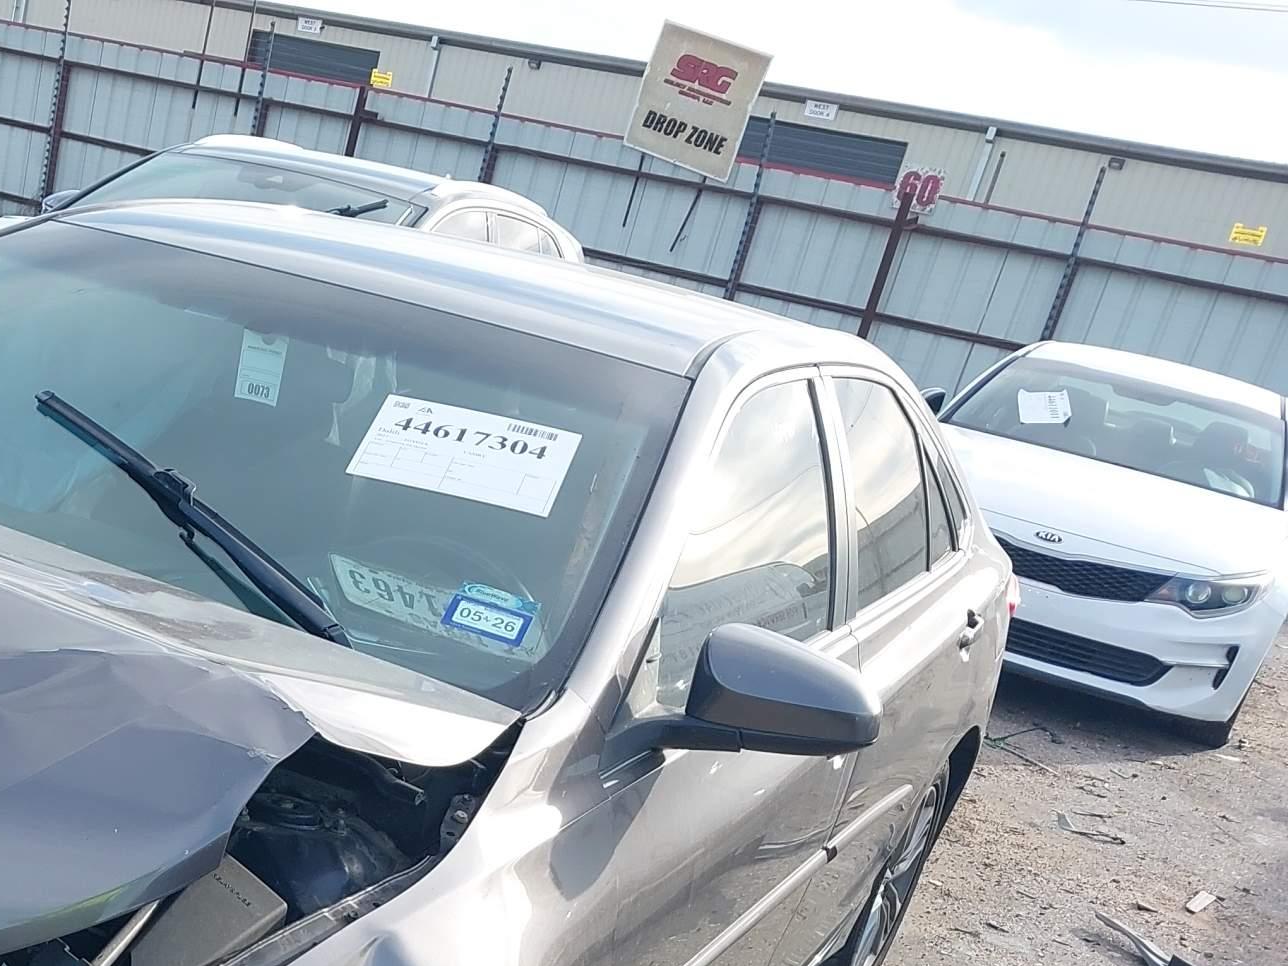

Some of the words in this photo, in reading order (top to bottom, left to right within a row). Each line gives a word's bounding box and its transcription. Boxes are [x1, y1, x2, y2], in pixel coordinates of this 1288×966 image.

[670, 54, 738, 94] SRG
[642, 110, 687, 139] DROP
[685, 126, 728, 155] ZONE
[896, 171, 941, 207] 60
[248, 382, 270, 399] 0073
[394, 417, 548, 461] 44617304
[1038, 531, 1060, 542] KIA
